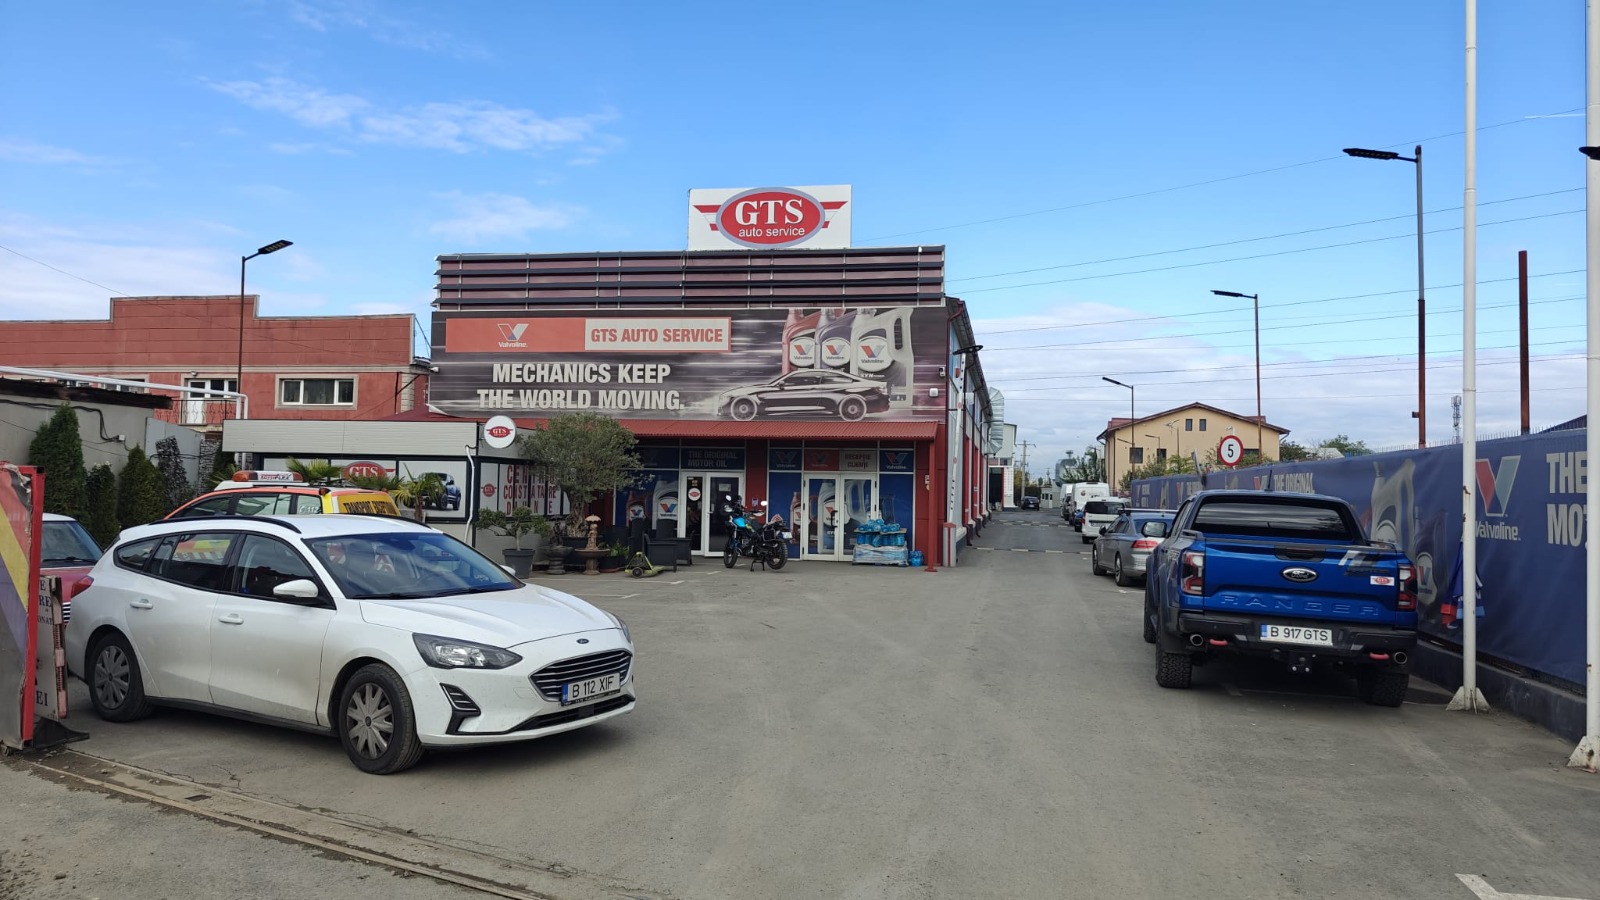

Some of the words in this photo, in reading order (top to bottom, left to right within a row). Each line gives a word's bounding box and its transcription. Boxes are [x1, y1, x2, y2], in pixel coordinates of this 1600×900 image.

[735, 198, 804, 226] GTS
[738, 228, 763, 237] auto
[766, 227, 805, 237] service
[591, 328, 618, 343] GTS
[621, 328, 659, 343] AUTO
[662, 328, 723, 343] SERVICE
[492, 363, 611, 383] MECHANICS
[618, 363, 671, 383] KEEP
[477, 389, 518, 409] THE
[520, 389, 591, 409] WORLD
[598, 389, 684, 410] MOVING.
[1227, 444, 1234, 457] 5
[349, 466, 378, 478] GTS
[1546, 451, 1587, 494] THE
[1274, 475, 1284, 491] THE
[1547, 503, 1587, 547] MO
[1221, 593, 1380, 616] RANGER
[1271, 627, 1279, 637] B
[1283, 627, 1302, 639] 917
[1303, 629, 1328, 641] GTS
[572, 684, 580, 698] B
[583, 679, 595, 695] 112
[599, 676, 615, 692] XIF
